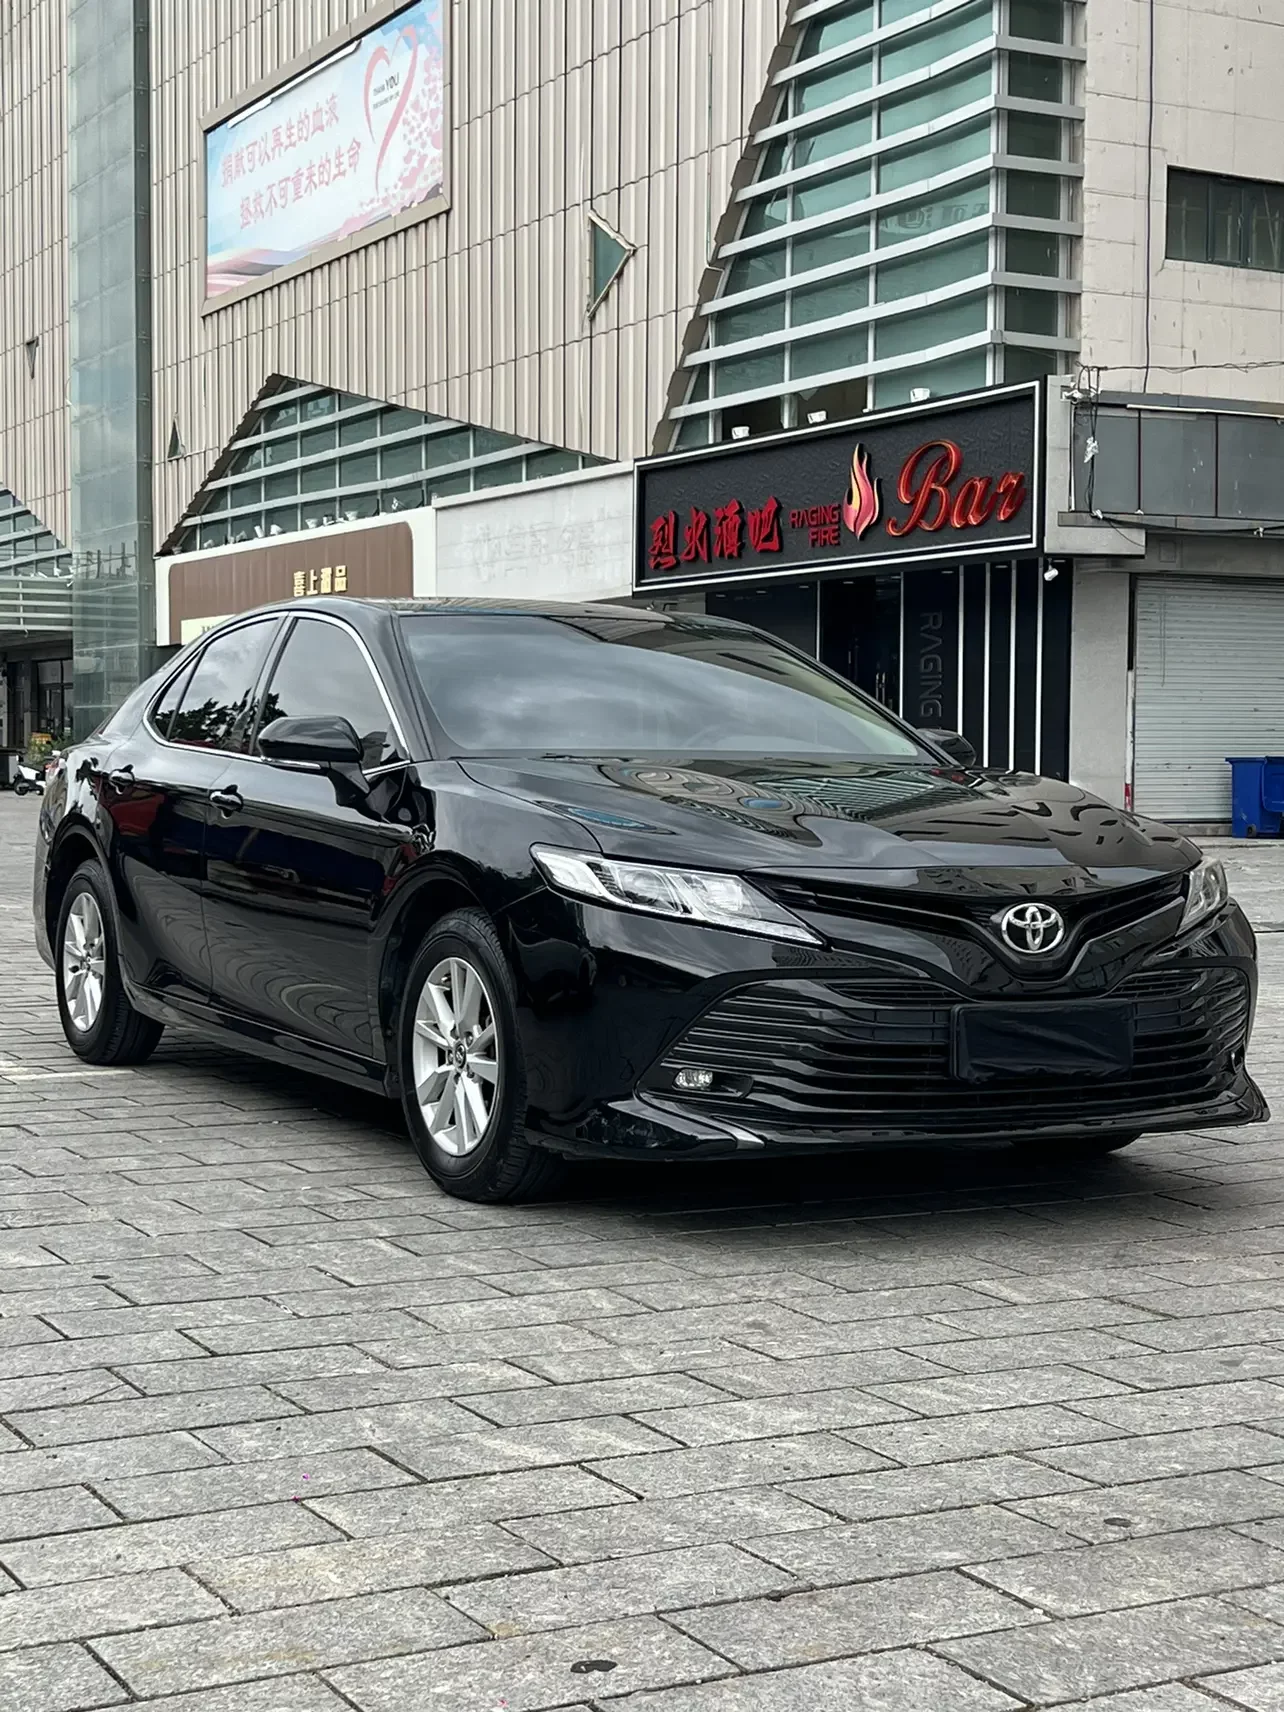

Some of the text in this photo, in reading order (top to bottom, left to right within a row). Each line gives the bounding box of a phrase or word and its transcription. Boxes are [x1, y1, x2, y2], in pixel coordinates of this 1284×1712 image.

[221, 93, 339, 187] 捐献可以再生的血液
[240, 137, 361, 229] 拯救不可重来的生命
[648, 496, 781, 570] 烈火酒吧
[789, 504, 840, 529] RAGING
[886, 439, 1027, 538] Bar
[808, 526, 840, 547] FIRE
[920, 611, 943, 718] RAGING
